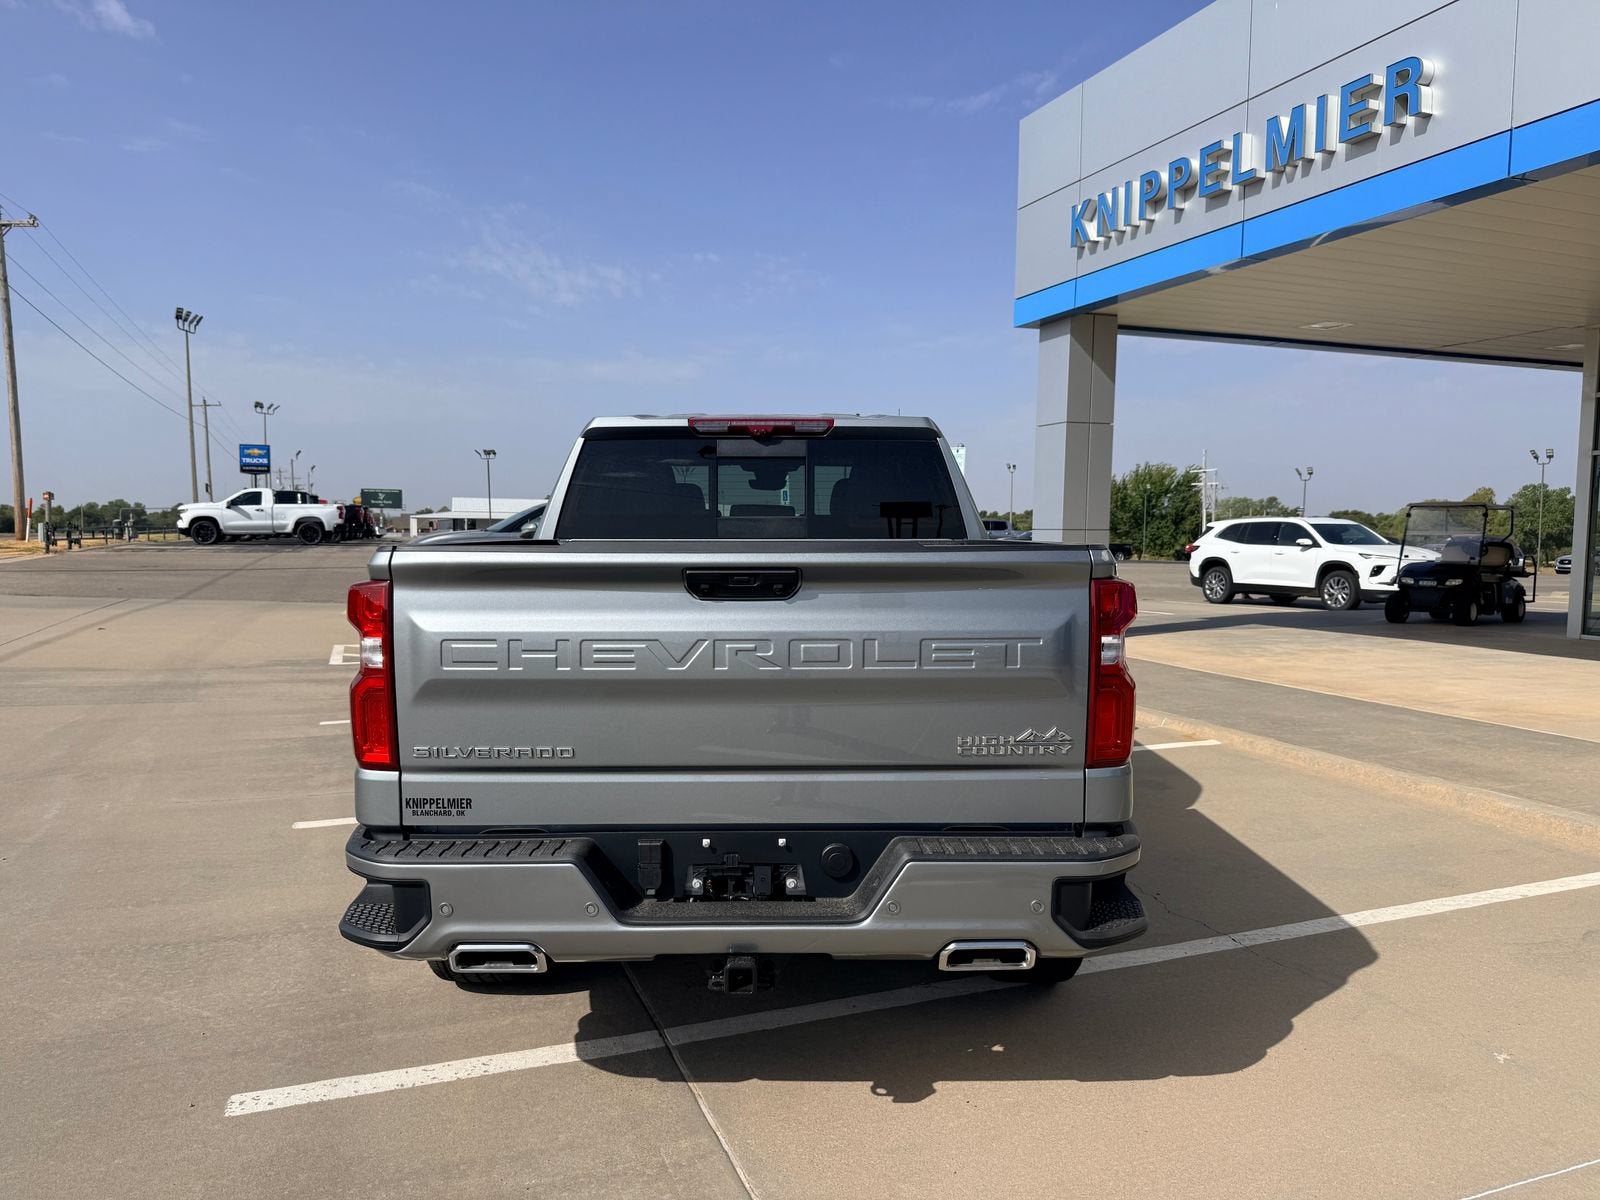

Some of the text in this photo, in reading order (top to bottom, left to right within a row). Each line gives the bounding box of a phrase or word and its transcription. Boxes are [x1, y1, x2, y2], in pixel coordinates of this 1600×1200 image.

[1070, 56, 1433, 248] KNIPPELMIER
[440, 638, 1044, 670] CHEVROLET
[957, 735, 1016, 746] HIGH
[412, 745, 576, 759] SILVERADO
[957, 745, 1073, 756] COUNTRY
[405, 797, 473, 810] KNIPPELMIER
[411, 809, 467, 818] BLANCHARD, OK
